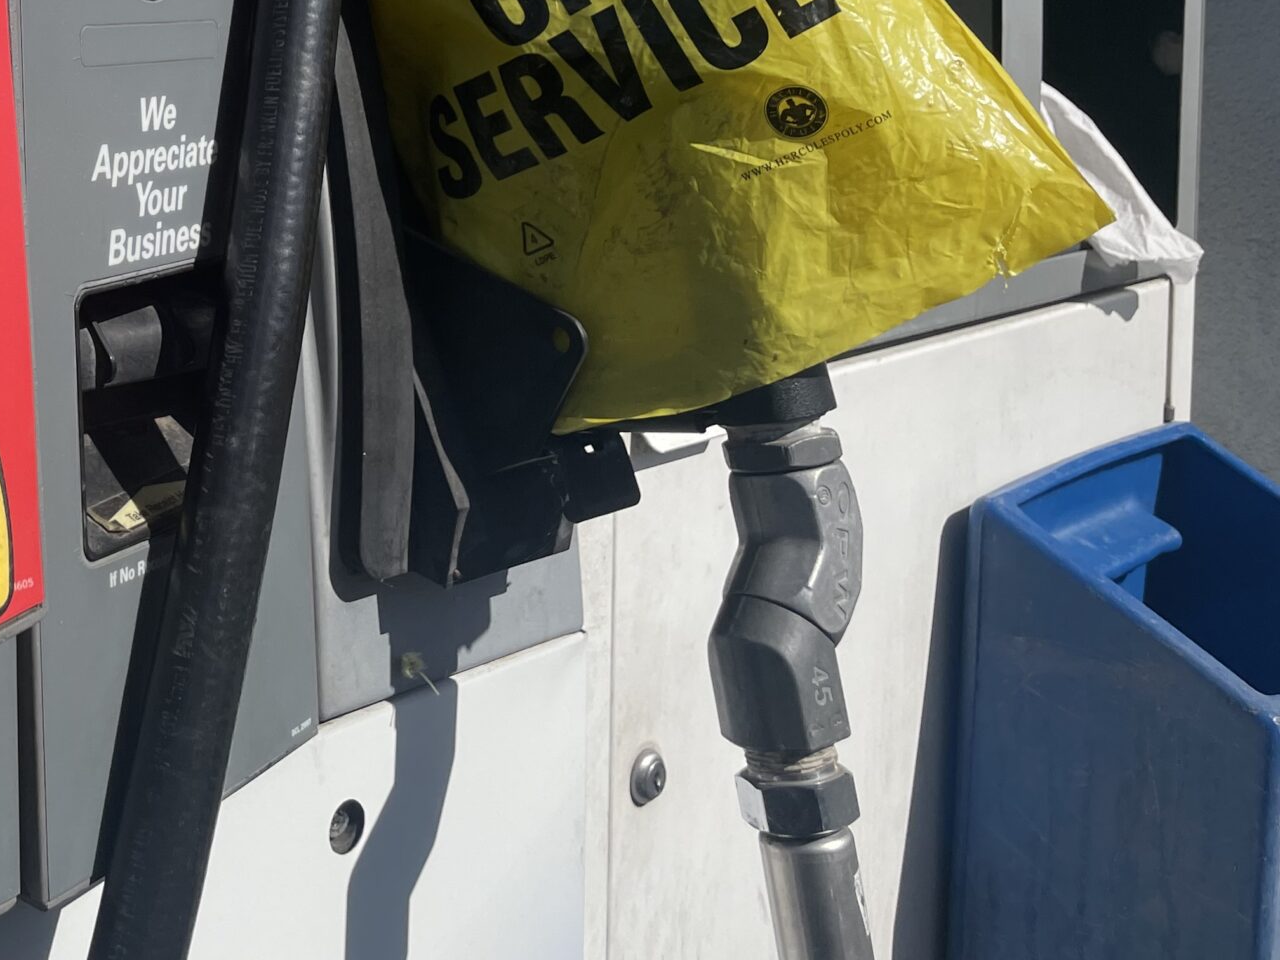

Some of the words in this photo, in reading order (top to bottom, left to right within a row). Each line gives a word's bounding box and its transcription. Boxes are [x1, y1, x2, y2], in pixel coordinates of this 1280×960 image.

[139, 95, 177, 133] We
[91, 134, 219, 187] Appreciate
[135, 181, 188, 218] Your
[108, 219, 212, 267] Business
[241, 217, 264, 250] FUEL
[109, 570, 118, 589] If
[120, 566, 136, 584] No
[812, 665, 834, 706] 45
